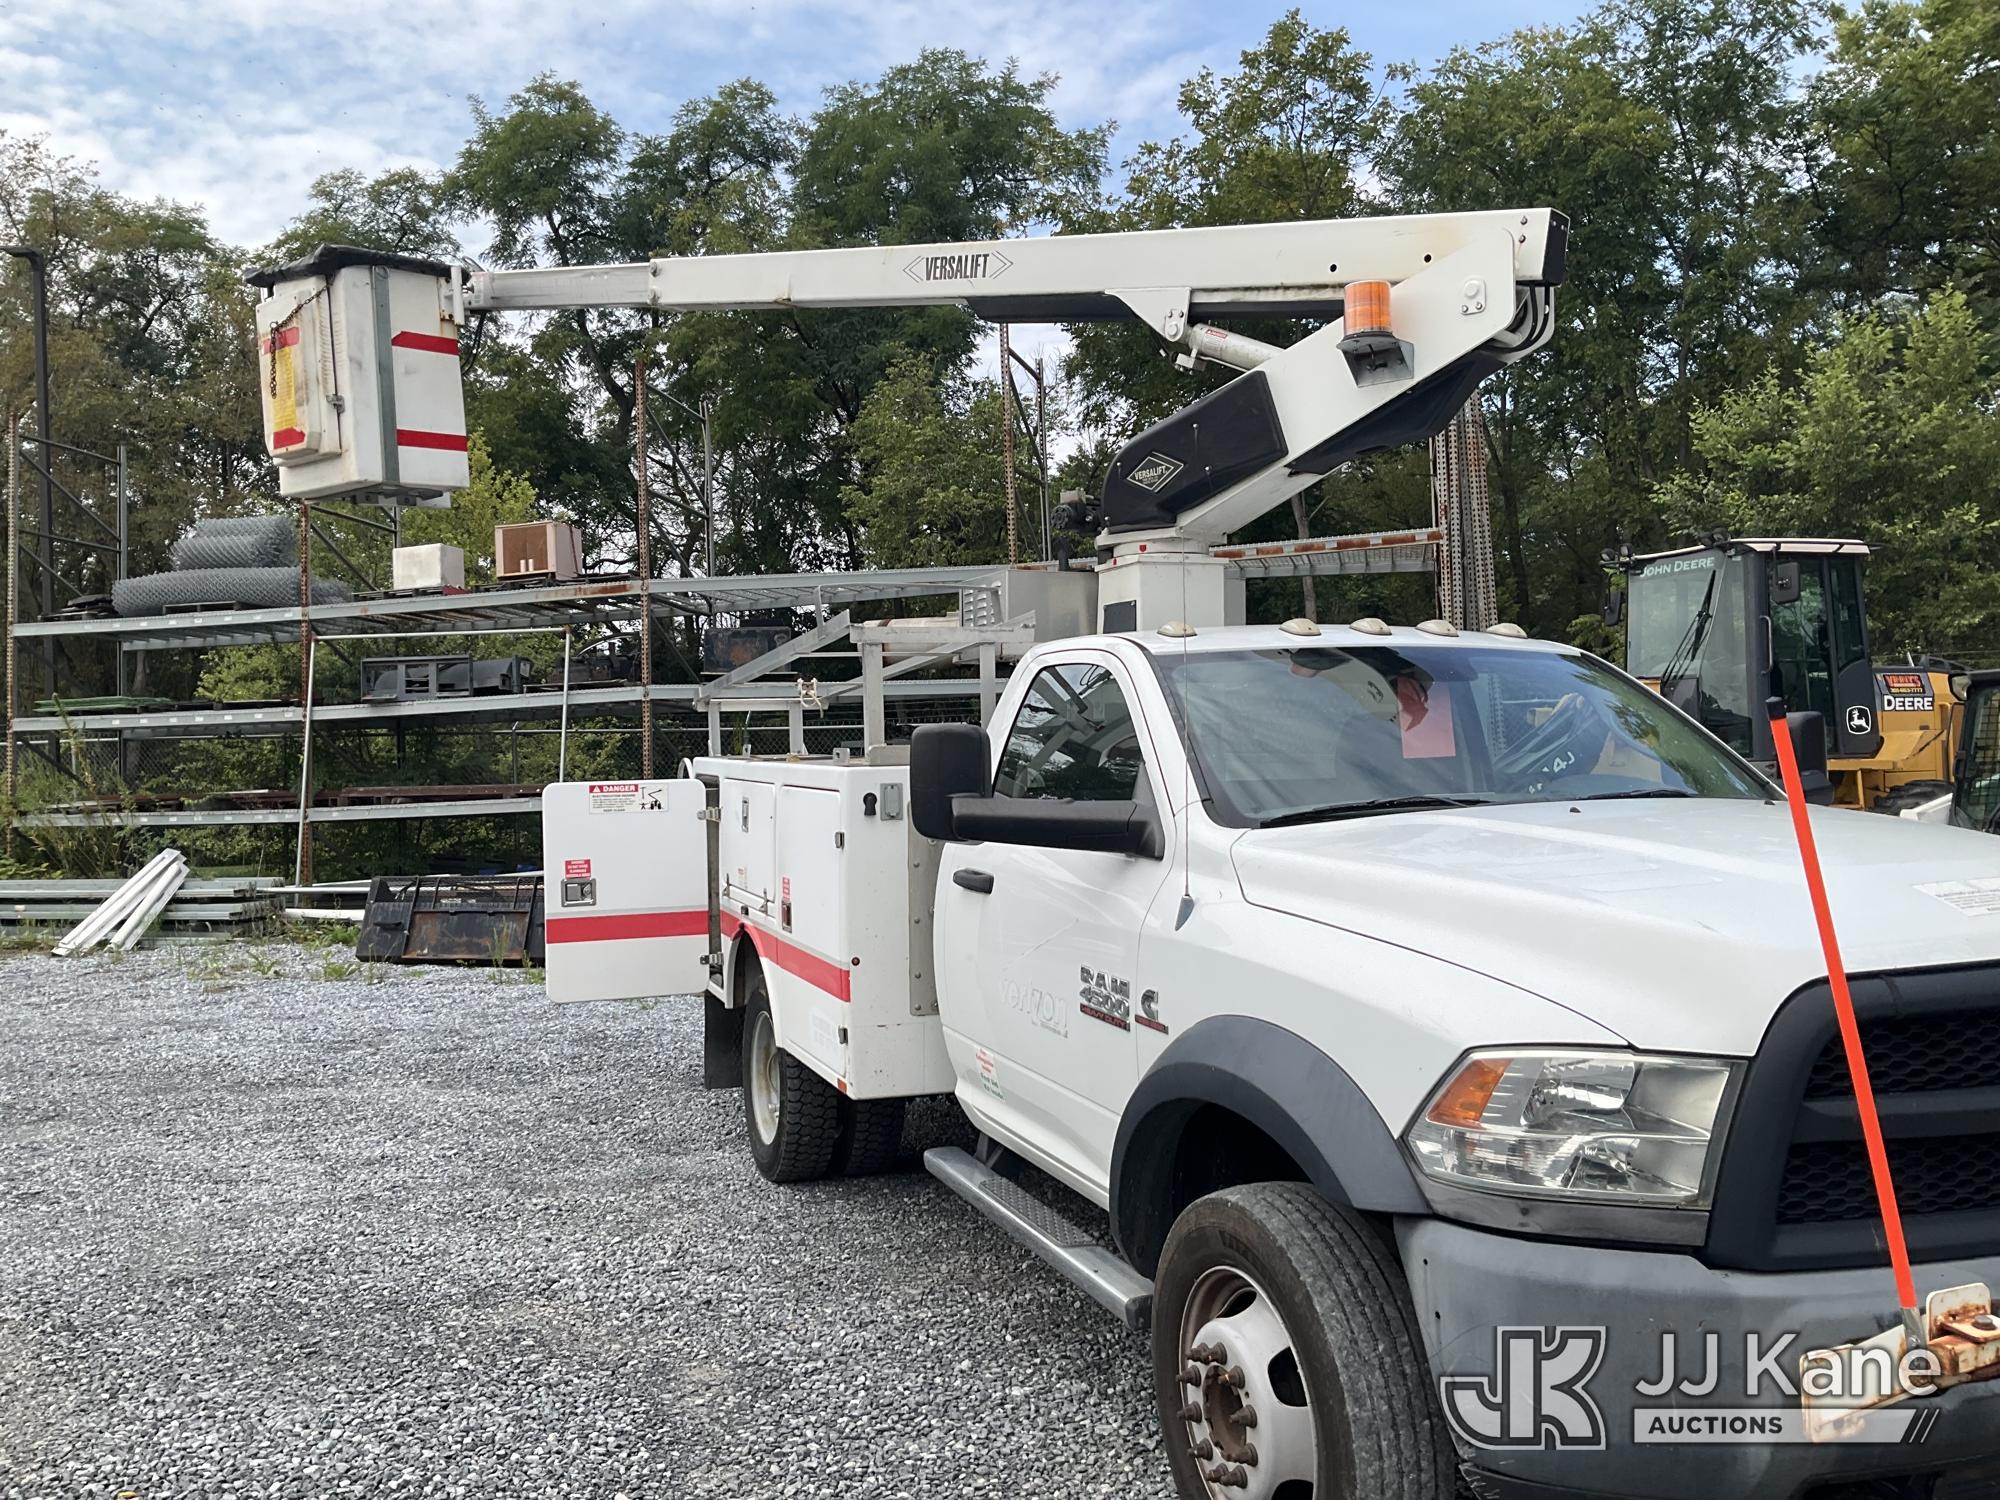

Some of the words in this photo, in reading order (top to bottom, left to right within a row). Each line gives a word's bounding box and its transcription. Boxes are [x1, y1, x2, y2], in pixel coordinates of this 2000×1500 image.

[925, 253, 990, 281] VERSALIFT
[1134, 465, 1167, 481] VERSALIFT
[1640, 563, 1671, 578] JOHN
[1674, 557, 1715, 572] DEERE
[1883, 694, 1933, 711] DEERE
[602, 785, 636, 793] DANGER
[1080, 965, 1130, 1000] RAM
[1079, 986, 1130, 1019] 4500
